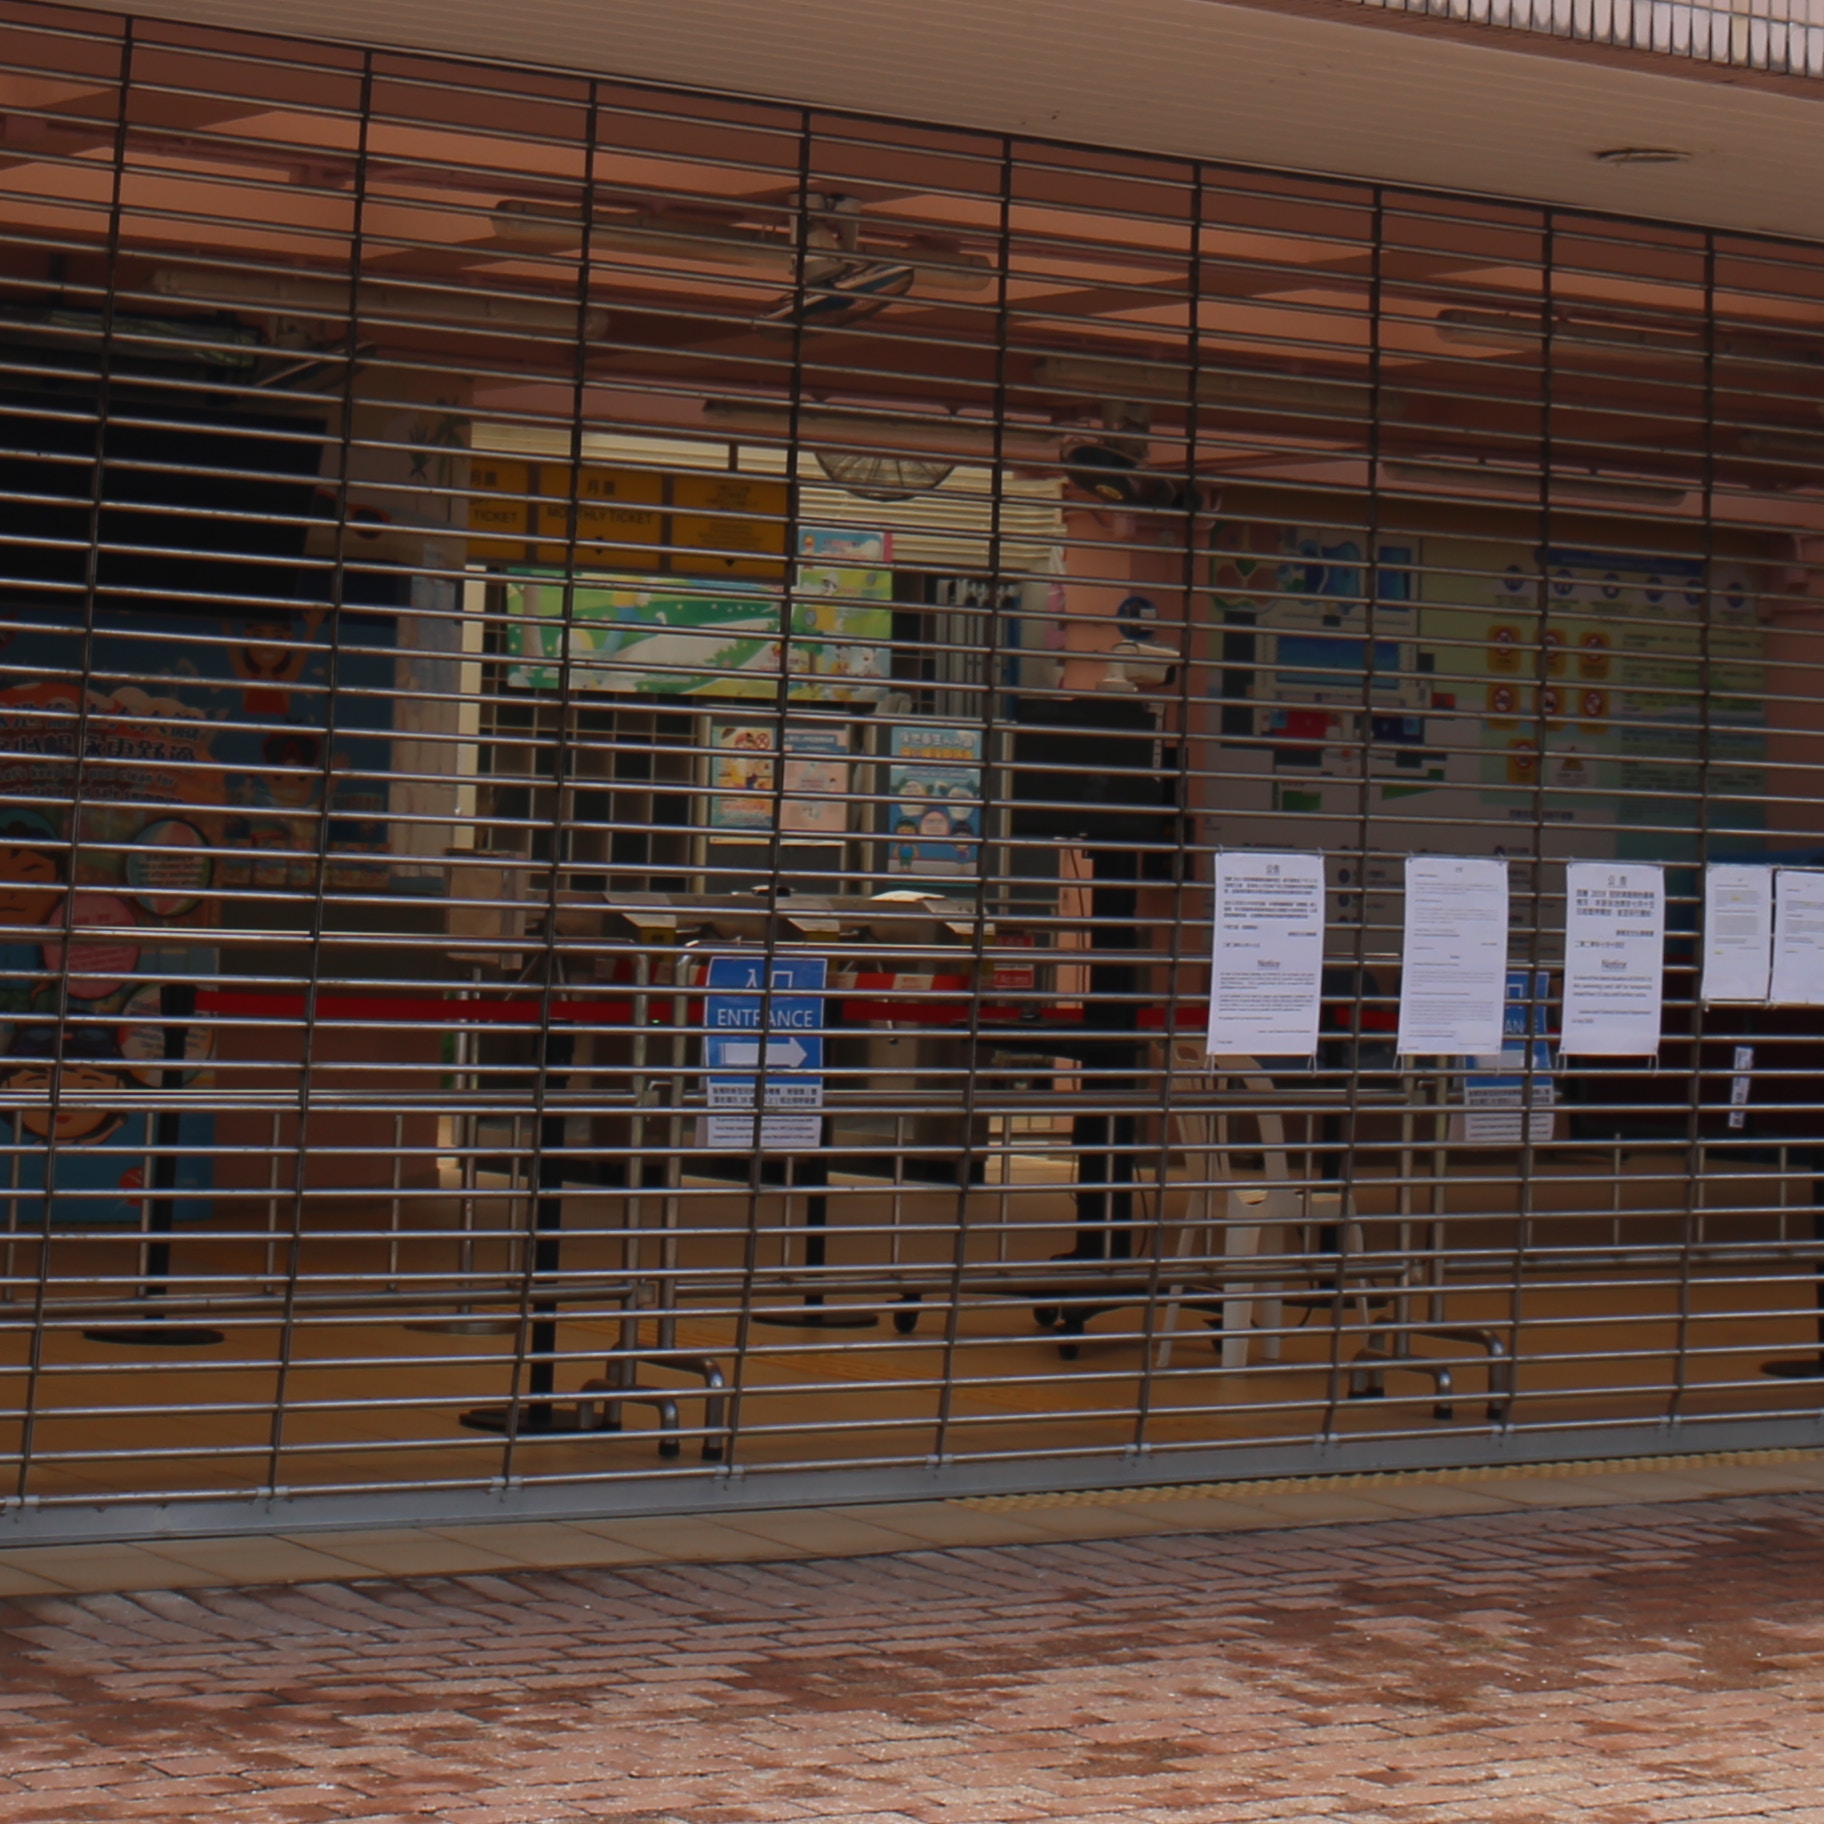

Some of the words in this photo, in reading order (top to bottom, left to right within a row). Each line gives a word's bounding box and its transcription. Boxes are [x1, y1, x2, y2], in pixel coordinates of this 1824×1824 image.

[474, 508, 518, 524] TICKET
[548, 505, 607, 522] MOTHLY
[609, 508, 652, 525] TICKET
[1600, 959, 1628, 972] Notice
